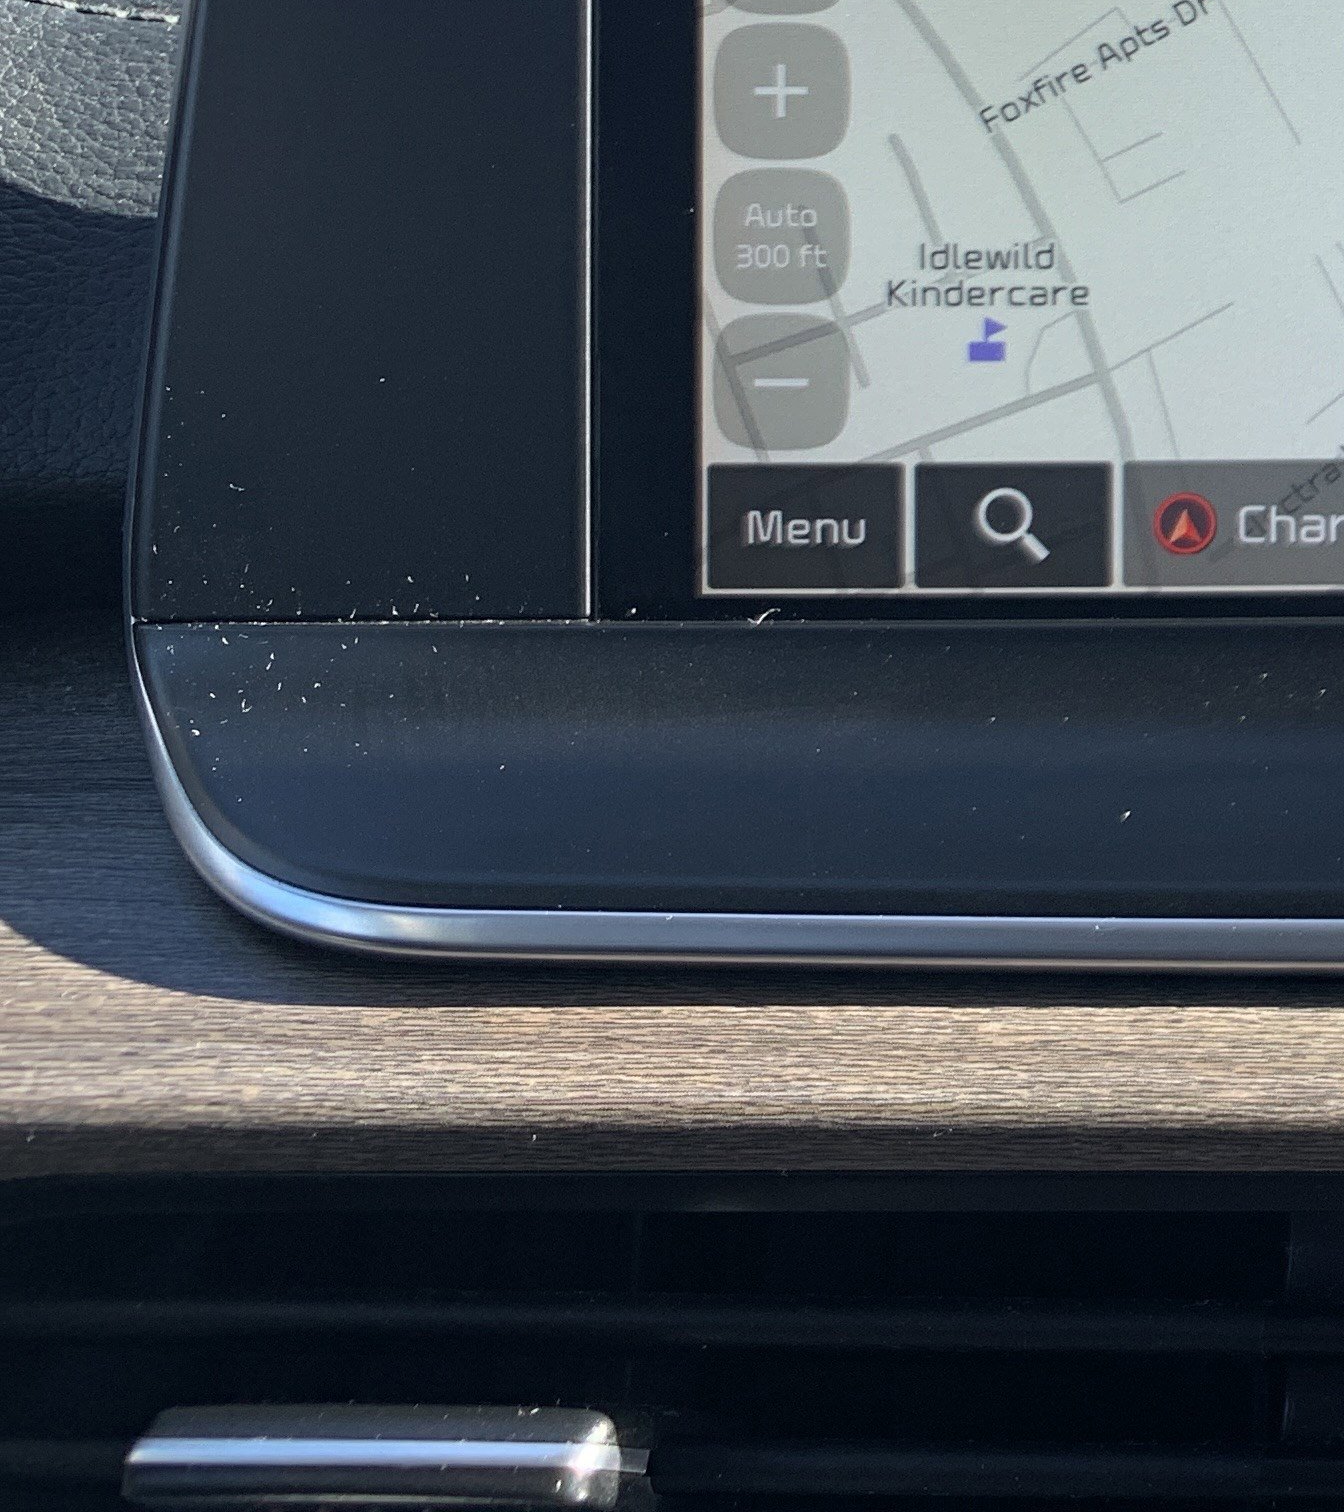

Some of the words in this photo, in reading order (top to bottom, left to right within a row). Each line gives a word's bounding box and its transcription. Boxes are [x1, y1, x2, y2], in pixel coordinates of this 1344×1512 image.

[978, 62, 1093, 134] Foxfire
[1097, 18, 1172, 71] Apts
[743, 202, 818, 229] Auto
[735, 243, 792, 270] 300
[797, 243, 829, 270] ft
[918, 241, 1057, 272] Idlewild
[886, 278, 1091, 308] Kindercare
[744, 508, 868, 546] Menu
